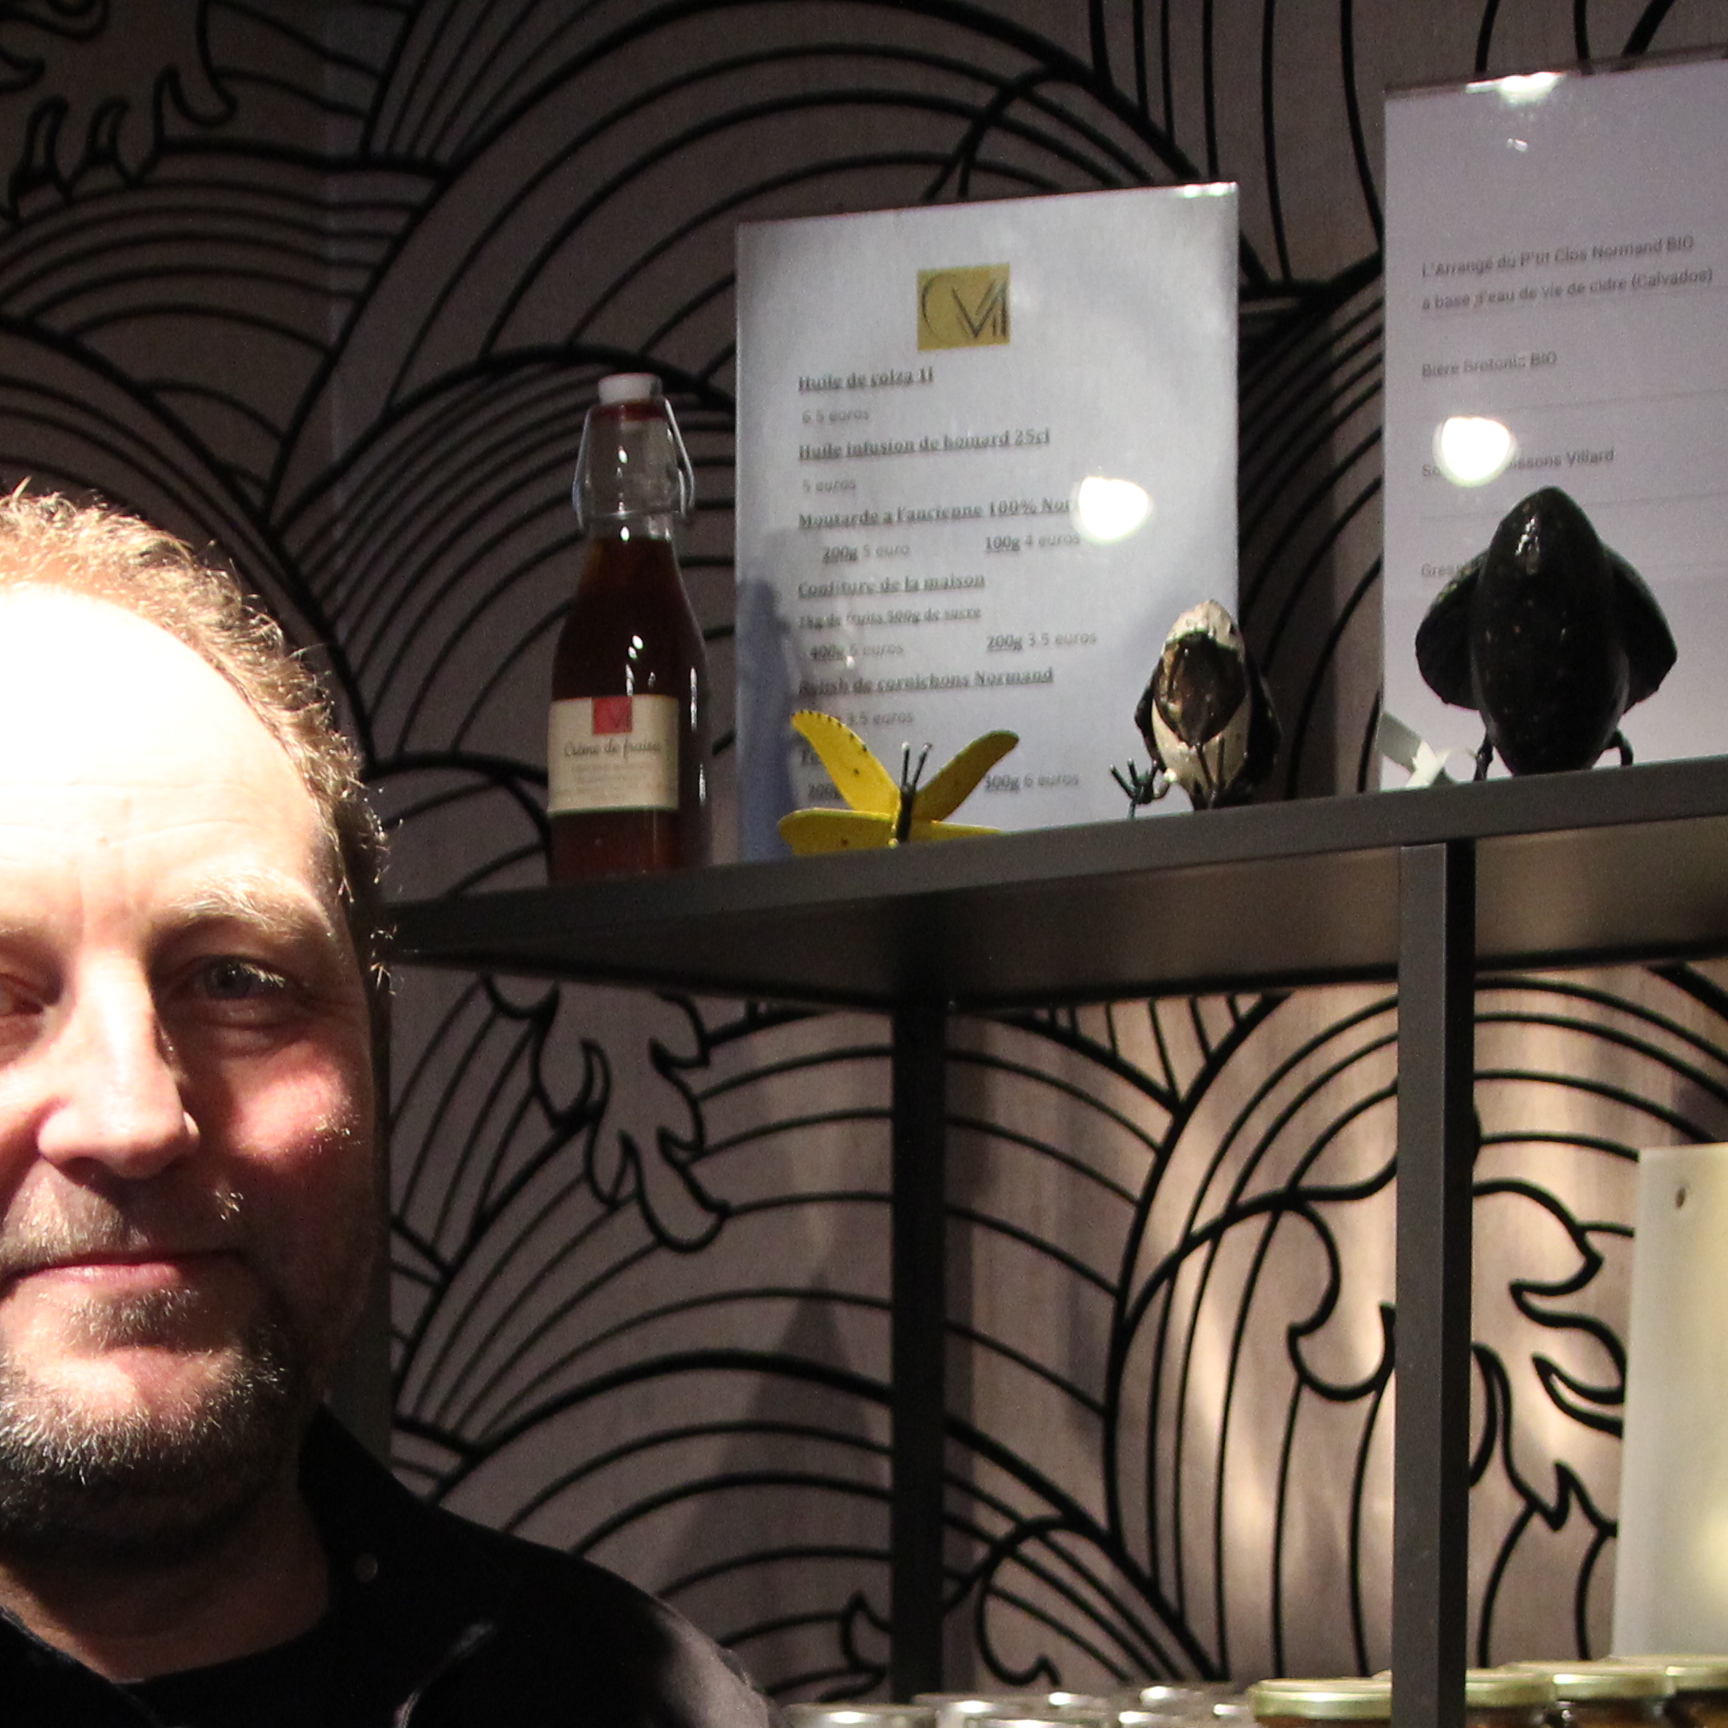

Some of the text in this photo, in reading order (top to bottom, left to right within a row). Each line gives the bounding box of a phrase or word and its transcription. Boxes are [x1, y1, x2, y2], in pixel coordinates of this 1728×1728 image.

[1497, 254, 1516, 270] du
[1555, 246, 1588, 263] Clos
[1592, 239, 1663, 259] Normand
[1666, 235, 1695, 253] BIO
[1435, 294, 1470, 308] base
[1519, 286, 1538, 300] de
[1542, 283, 1564, 298] vie
[1567, 282, 1586, 296] de
[1590, 277, 1627, 292] cidre
[1631, 267, 1713, 288] (Calvados)
[1530, 351, 1557, 368] BIO
[798, 367, 913, 391] Huile de colza
[828, 407, 870, 422] euros
[799, 443, 843, 461] Huile
[846, 438, 915, 458] infusion
[919, 435, 939, 453] de
[943, 430, 1010, 451] homard
[1567, 445, 1614, 467] Villard
[815, 479, 856, 493] euros
[799, 508, 878, 530] Moutarde
[989, 500, 1036, 518] 100%
[985, 533, 1022, 553] 100g
[1038, 530, 1080, 547] euros
[798, 574, 986, 599] Confiture de la maison
[987, 634, 1023, 653] 200g
[1055, 629, 1097, 646] euros
[849, 666, 1054, 694] de cornichons Normand
[873, 711, 915, 726] euros
[1037, 772, 1079, 788] euros
